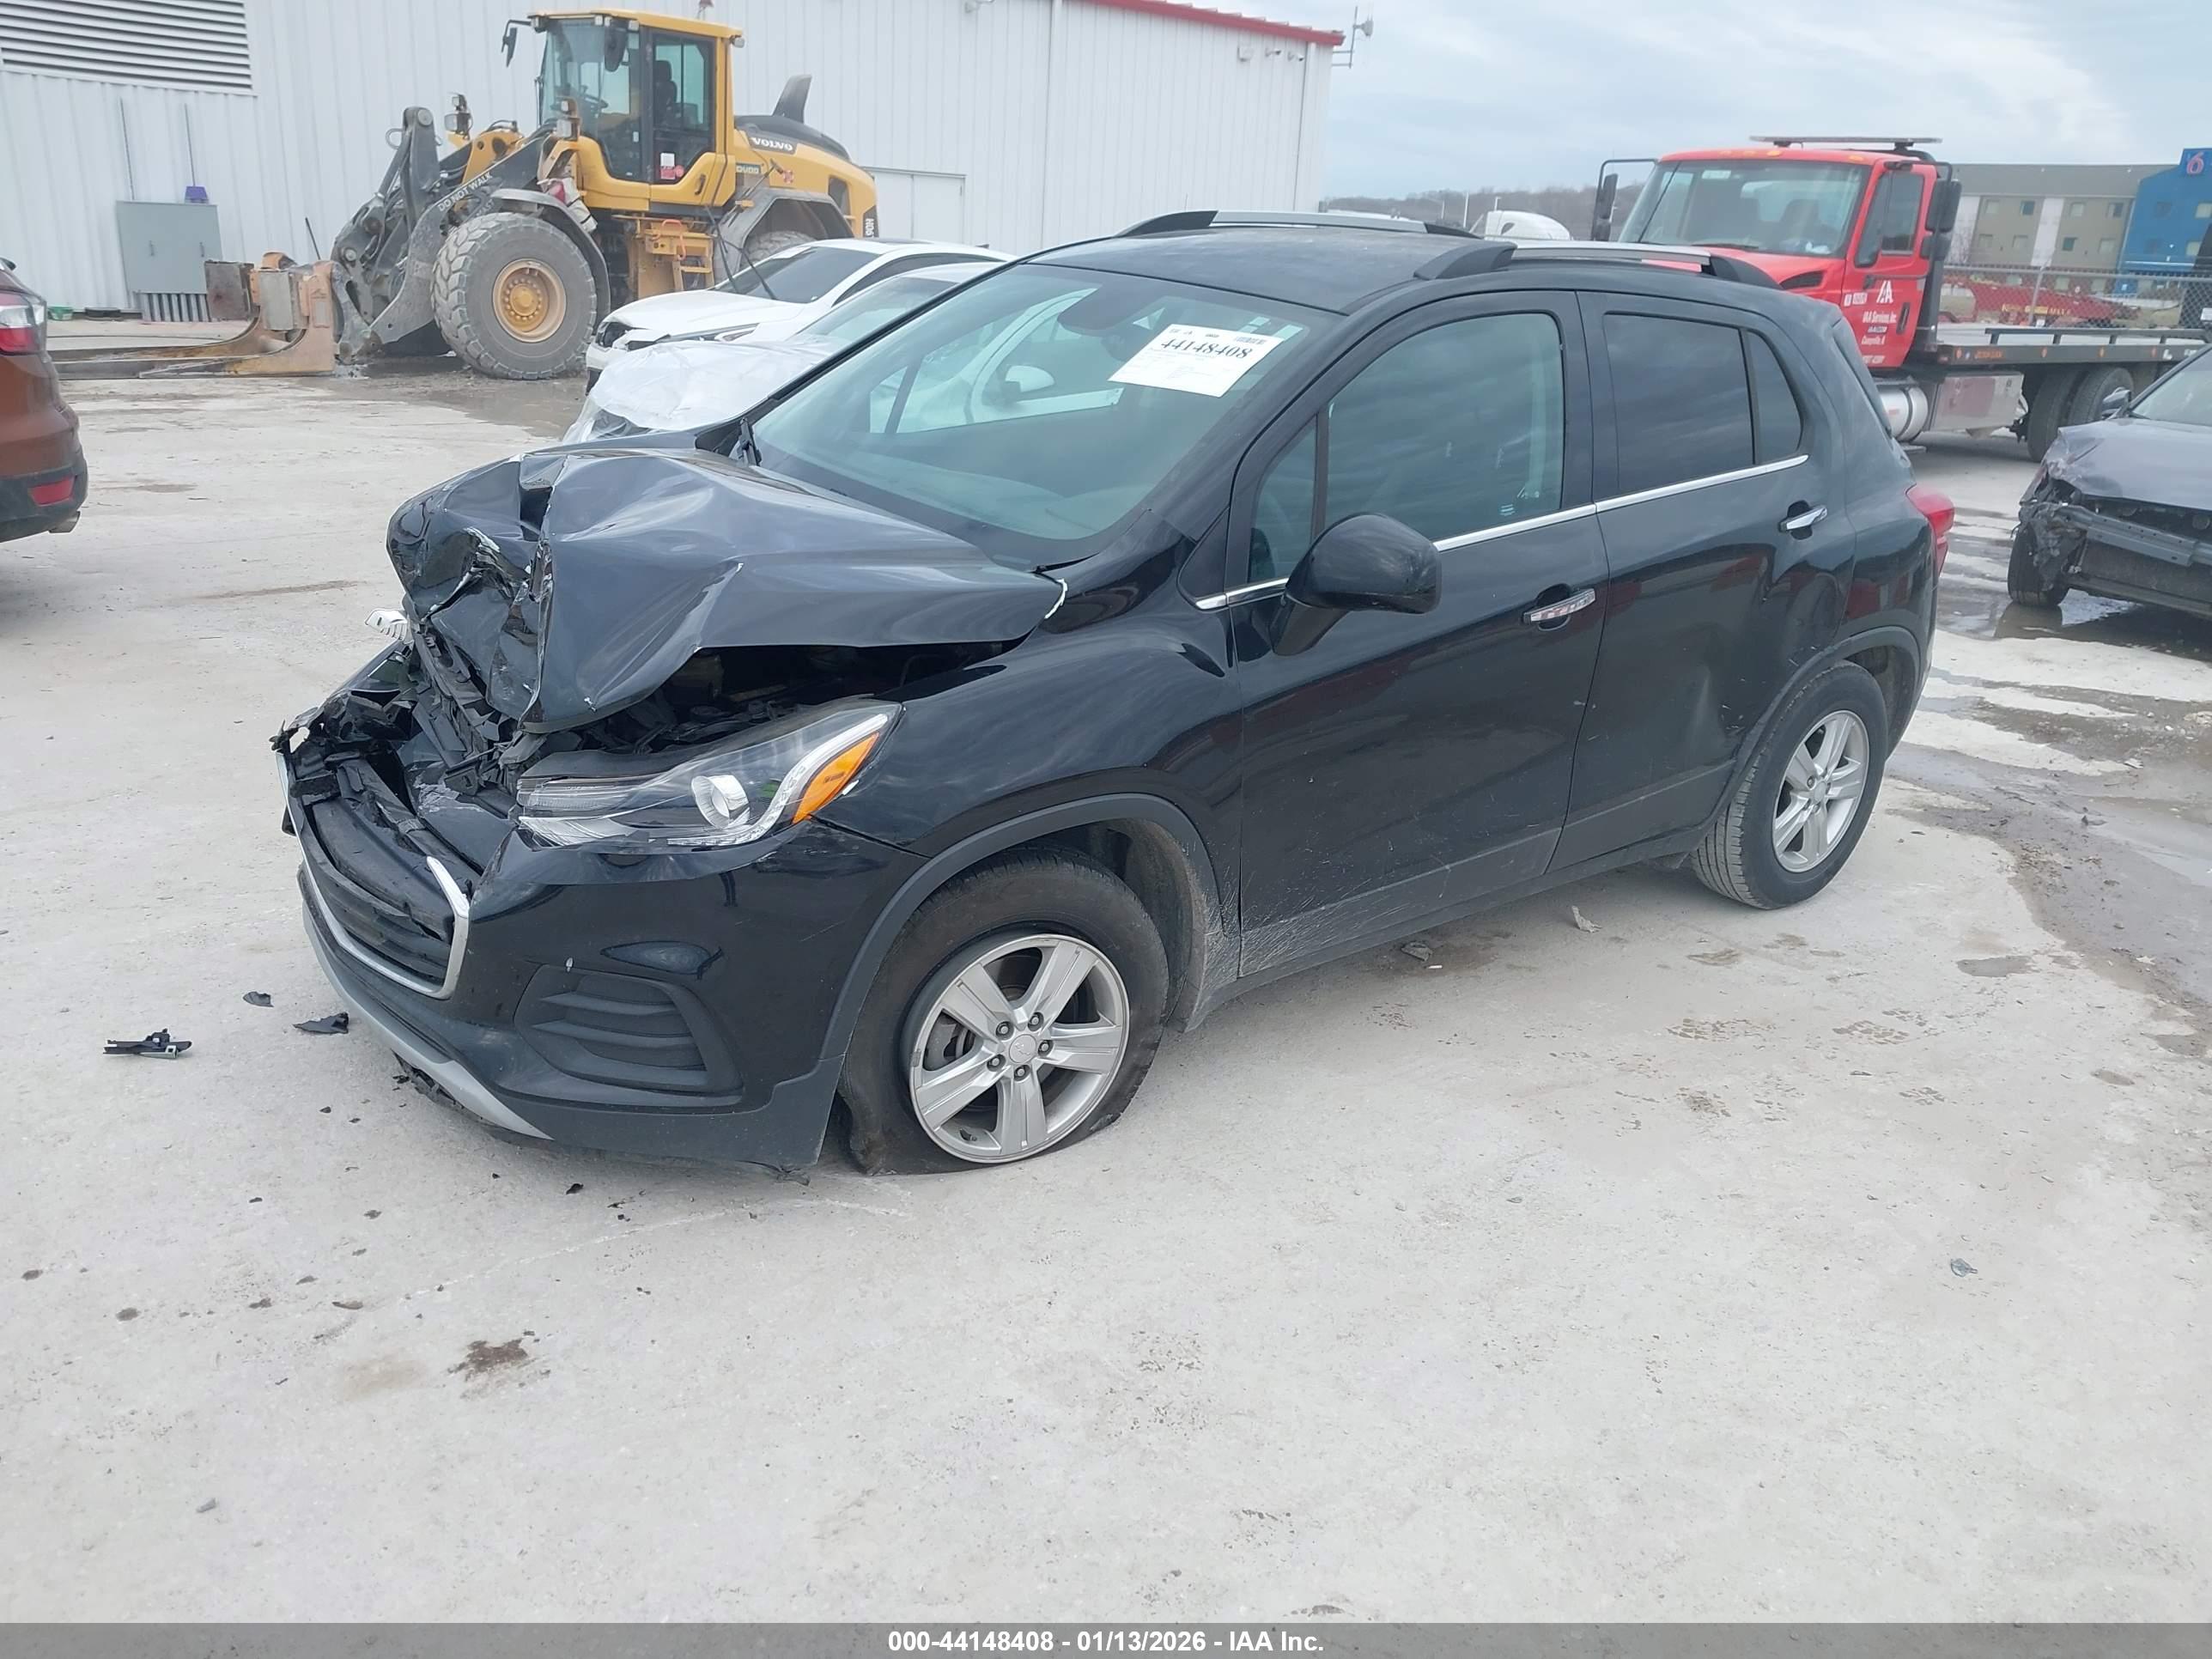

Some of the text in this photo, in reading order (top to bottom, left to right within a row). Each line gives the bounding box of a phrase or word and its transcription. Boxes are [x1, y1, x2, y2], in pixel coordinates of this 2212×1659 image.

[750, 137, 793, 151] VOLVO
[2186, 152, 2204, 174] 6
[469, 172, 493, 190] WALK
[1161, 338, 1252, 358] 44148408
